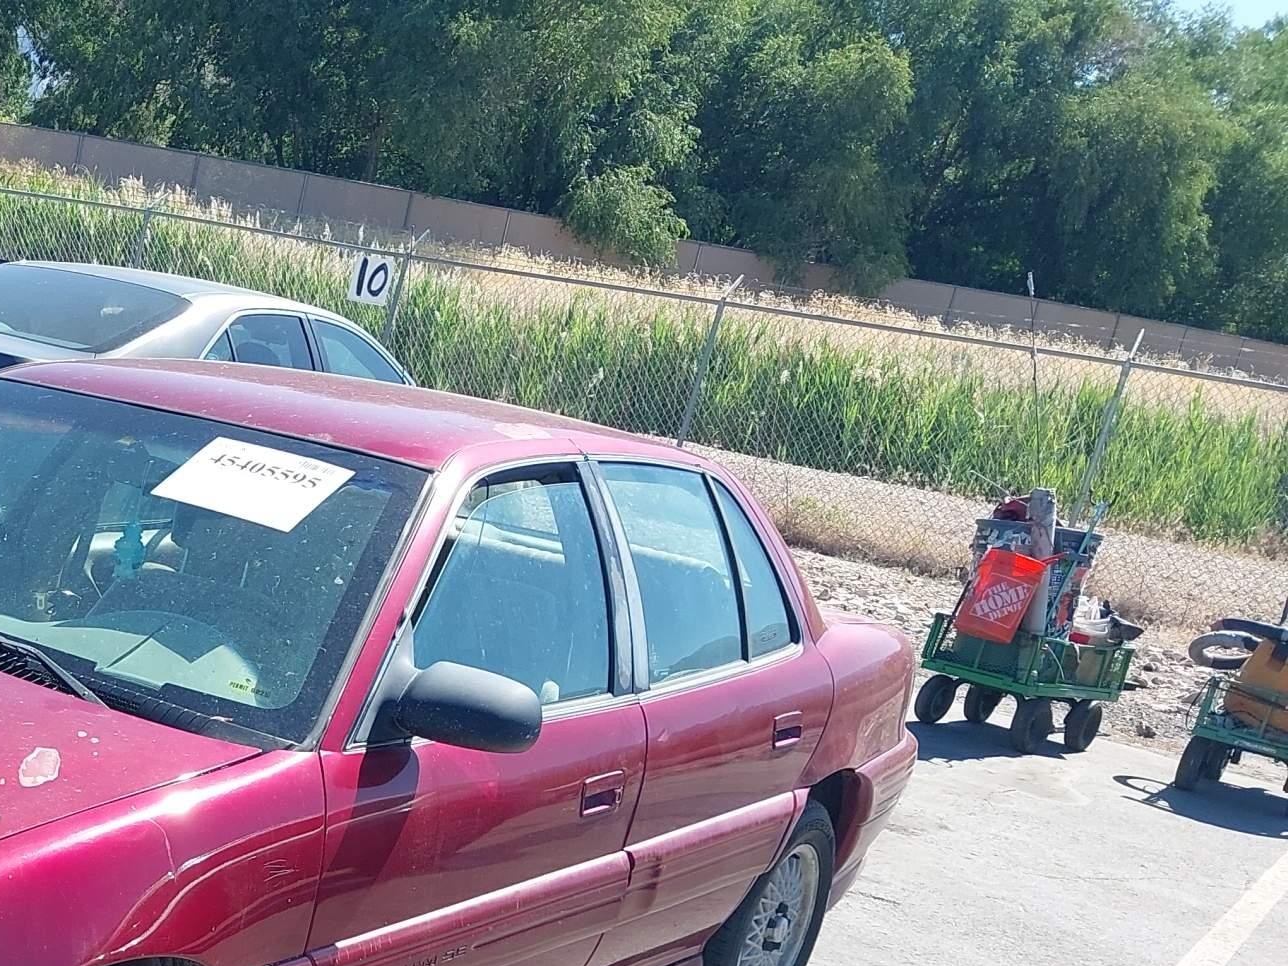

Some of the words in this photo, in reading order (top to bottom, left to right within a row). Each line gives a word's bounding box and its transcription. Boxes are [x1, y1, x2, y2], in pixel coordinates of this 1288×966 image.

[356, 256, 389, 297] 10
[210, 454, 322, 488] 45405595
[988, 582, 1009, 594] THE
[975, 585, 1030, 616] HOME
[988, 602, 1023, 620] DEPOT
[441, 945, 468, 963] SE
